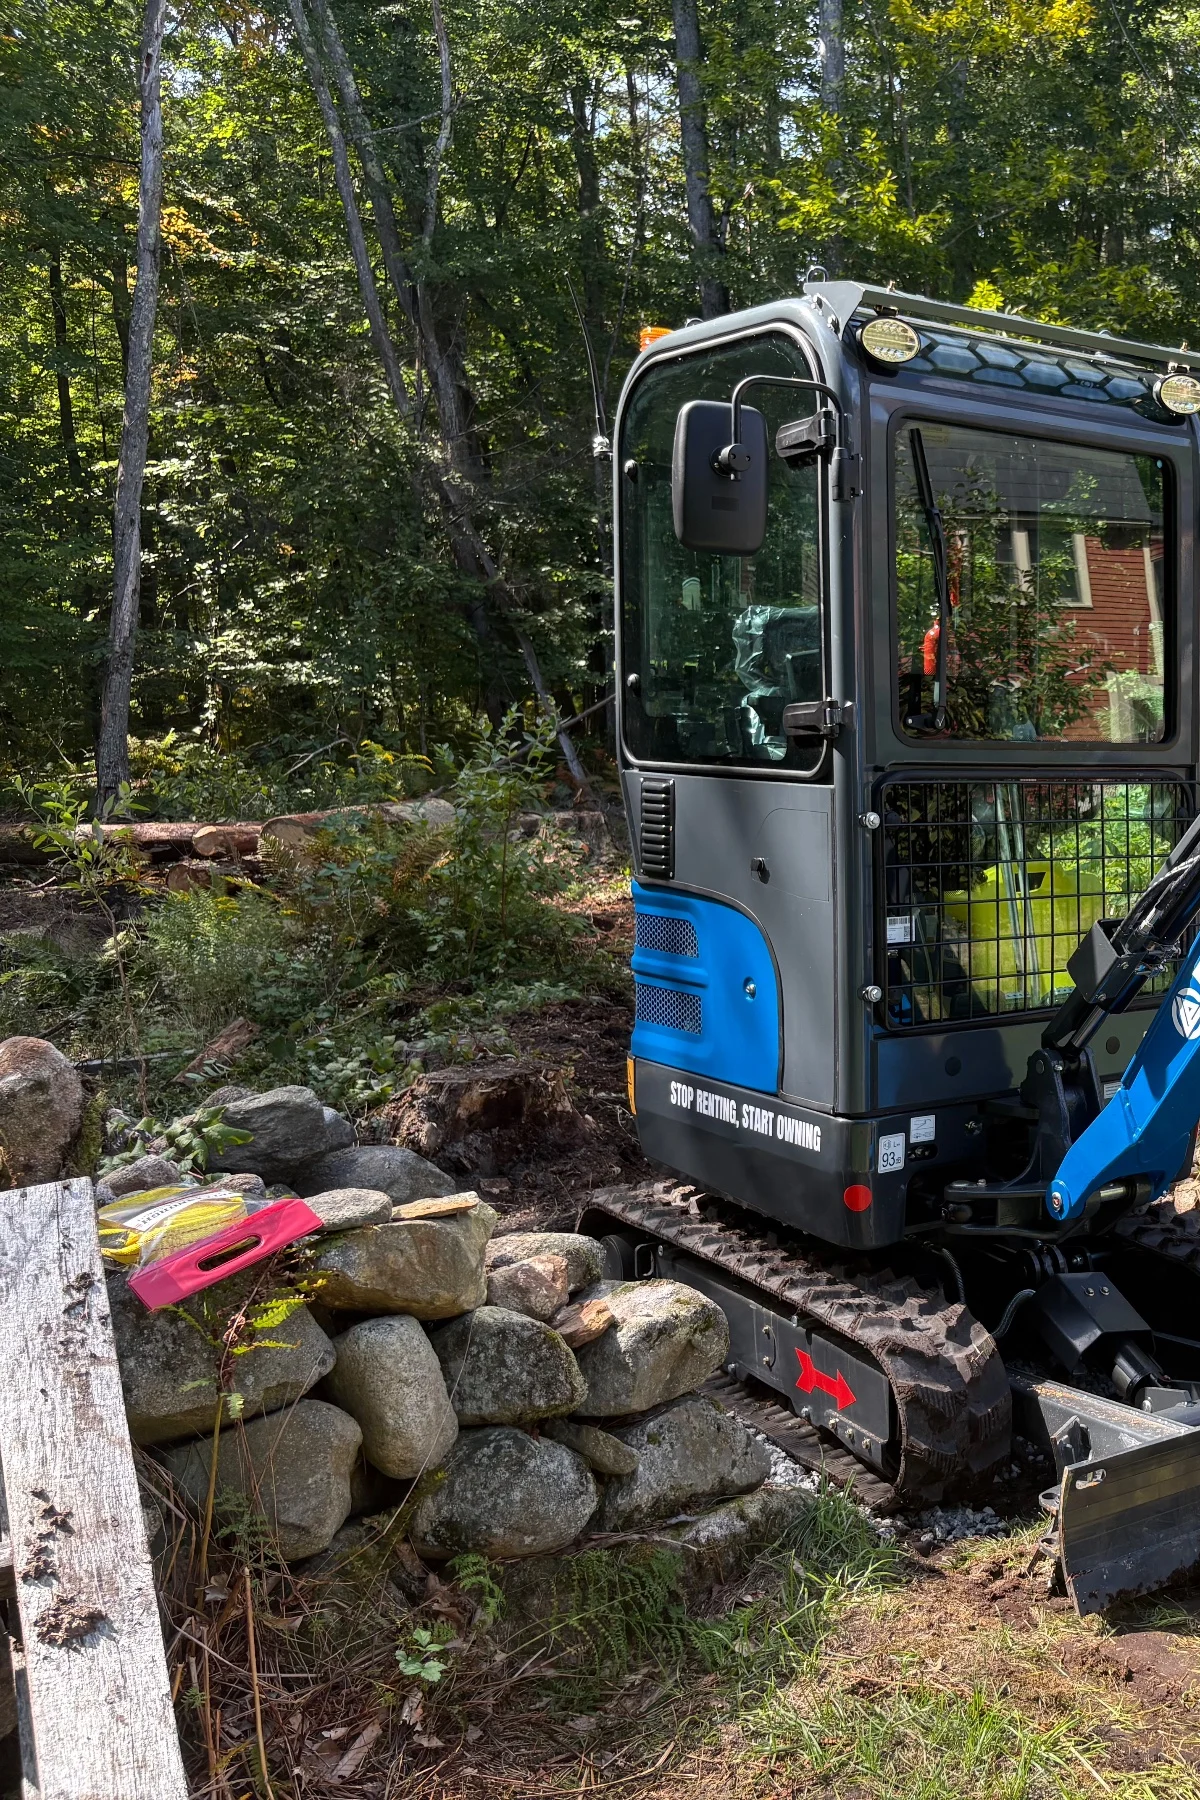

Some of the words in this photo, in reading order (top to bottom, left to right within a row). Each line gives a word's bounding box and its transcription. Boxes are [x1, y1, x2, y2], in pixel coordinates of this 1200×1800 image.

[670, 1080, 694, 1109] STOP
[696, 1088, 740, 1129] RENTING,
[741, 1103, 775, 1137] START
[776, 1114, 822, 1152] OWNING
[881, 1151, 896, 1168] 93
